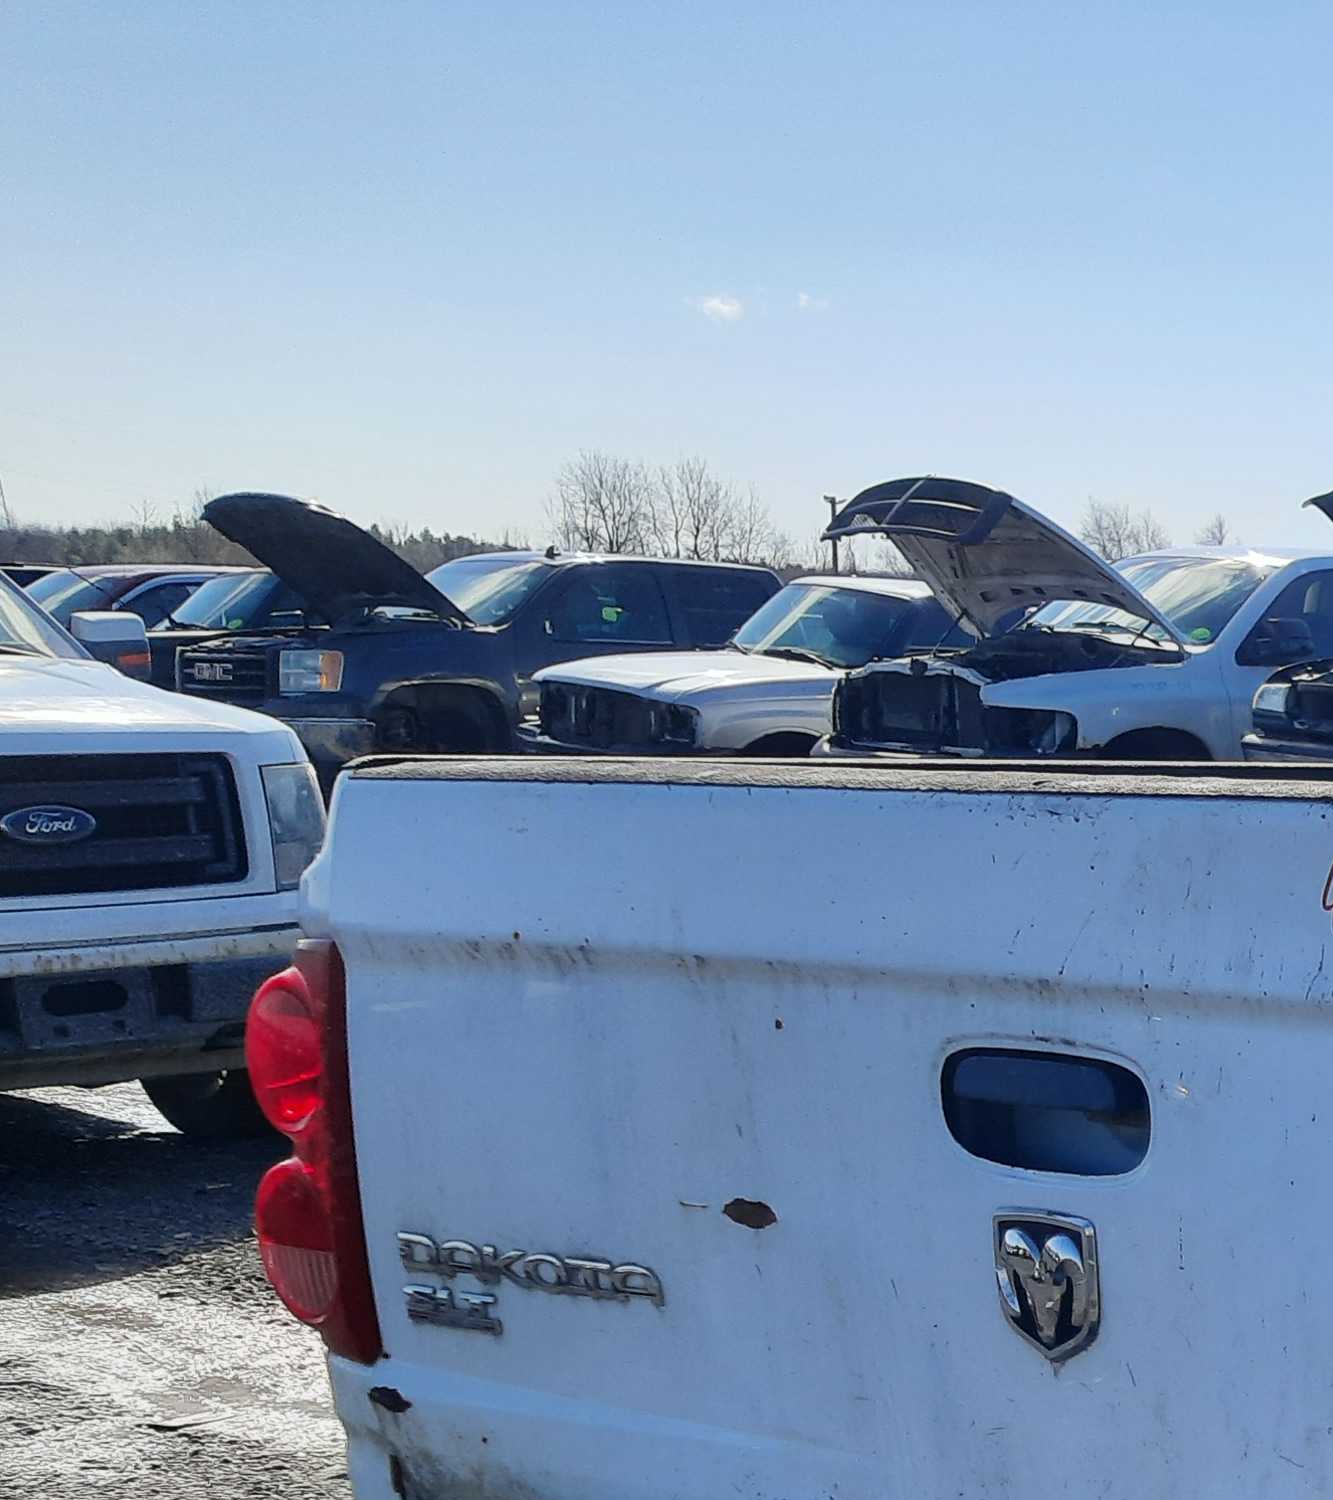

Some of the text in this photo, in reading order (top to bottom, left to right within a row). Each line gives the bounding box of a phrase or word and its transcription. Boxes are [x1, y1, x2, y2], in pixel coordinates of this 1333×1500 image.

[193, 662, 232, 680] GMC
[25, 811, 77, 833] Ford
[396, 1231, 666, 1310] DAKOTA
[402, 1283, 504, 1337] SLT
